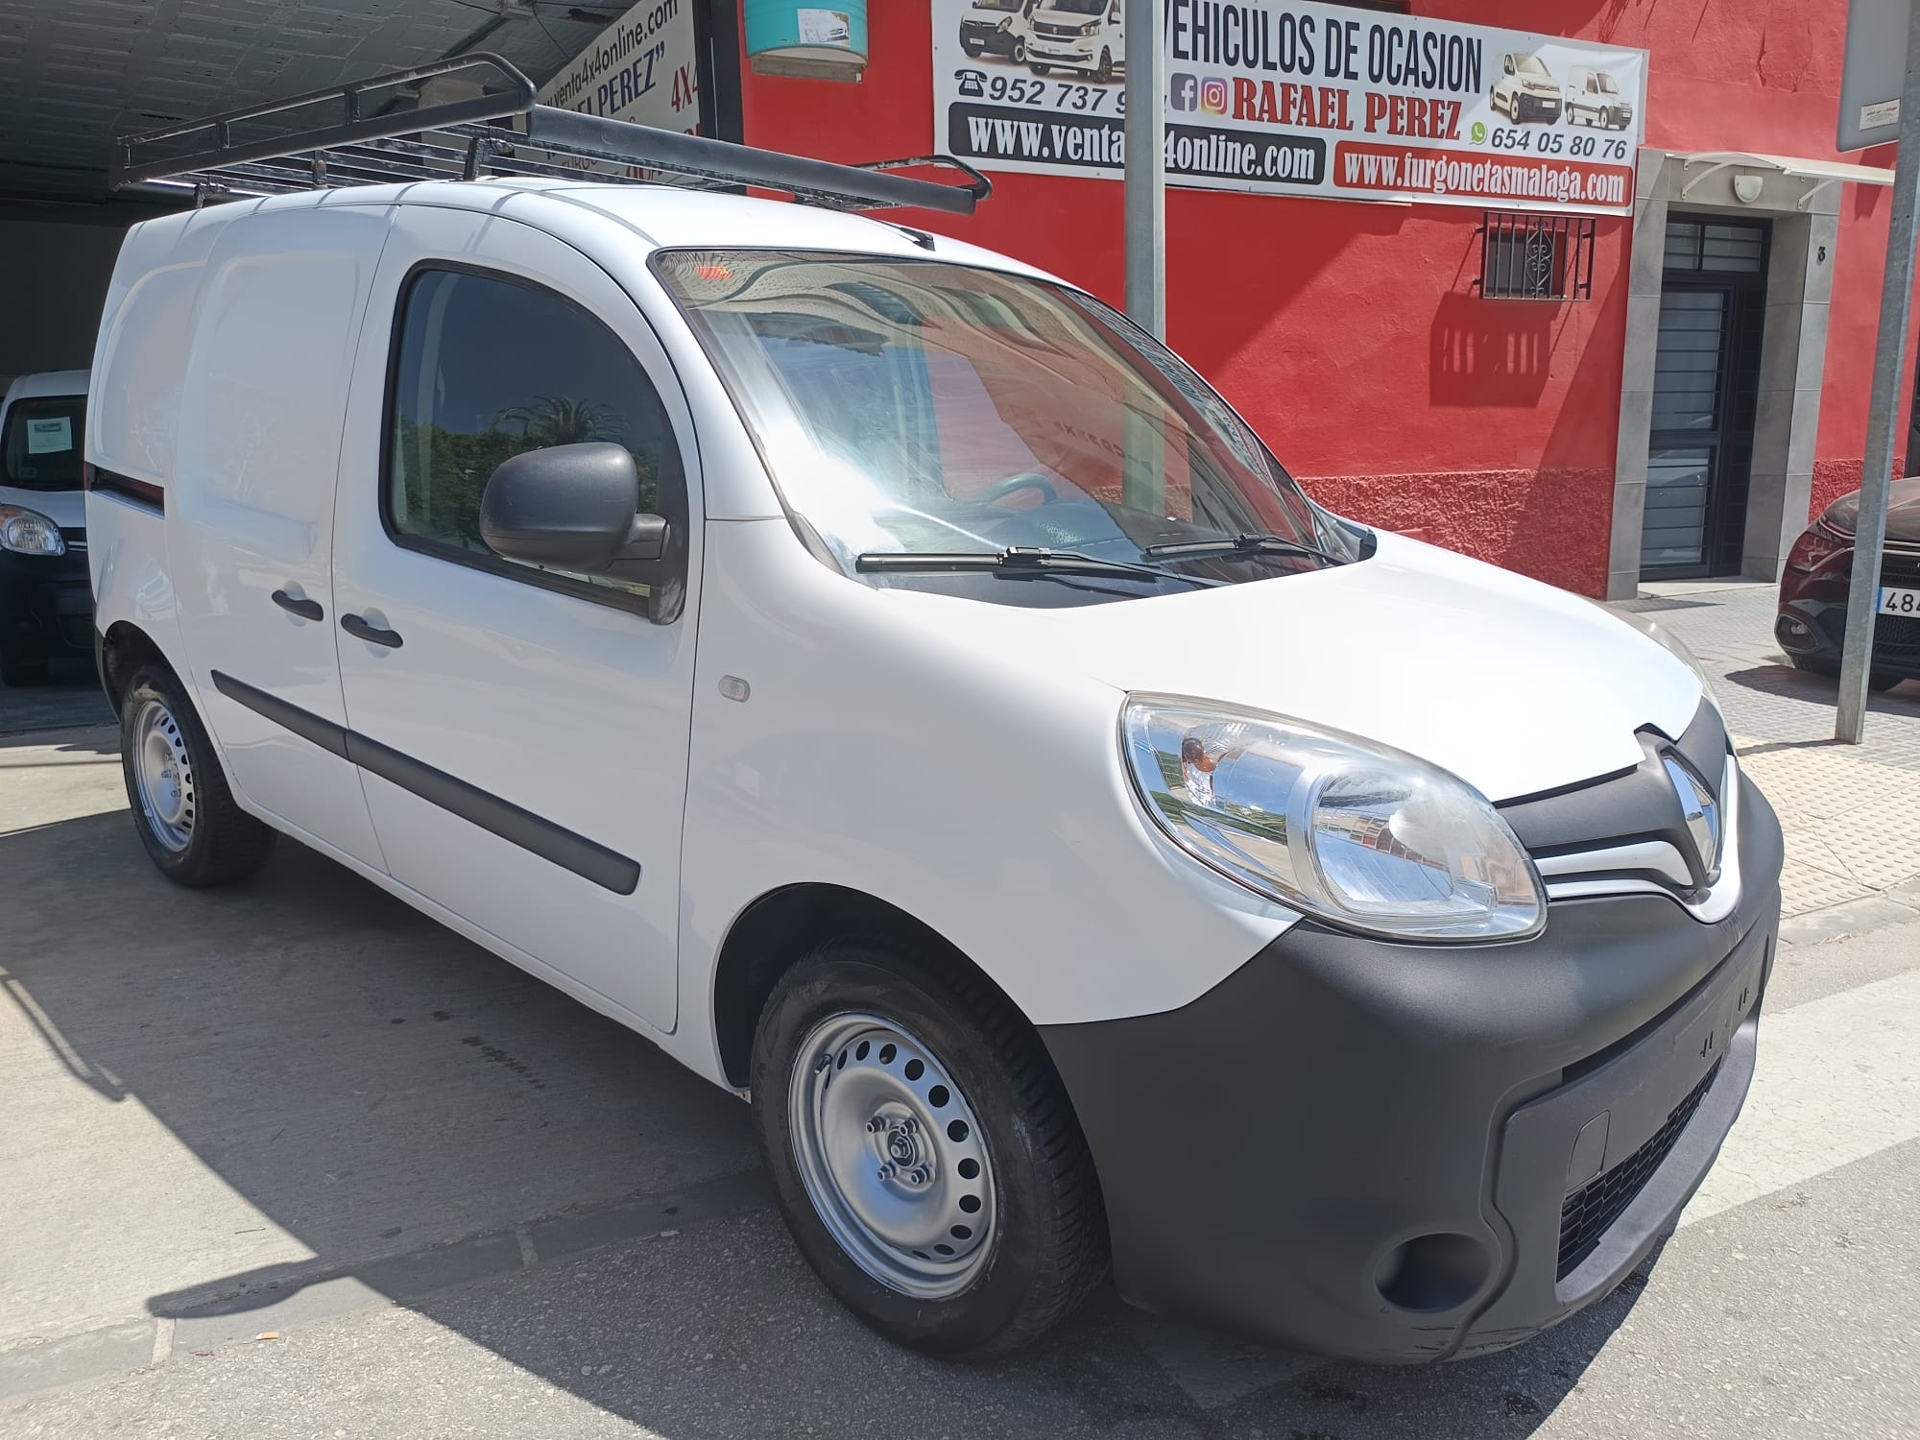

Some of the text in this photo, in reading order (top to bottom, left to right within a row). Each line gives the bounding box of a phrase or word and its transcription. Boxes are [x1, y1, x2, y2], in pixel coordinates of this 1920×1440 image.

[1164, 0, 1482, 94] EHICULOS DE OCASION
[989, 76, 1046, 106] 952
[1056, 83, 1108, 114] 737
[1232, 77, 1462, 140] RAFAEL PEREZ
[967, 116, 1315, 180] www.venta4online.com
[1491, 127, 1628, 160] 654 05 80 76
[1343, 151, 1624, 203] www.furgonetasmalaga.com
